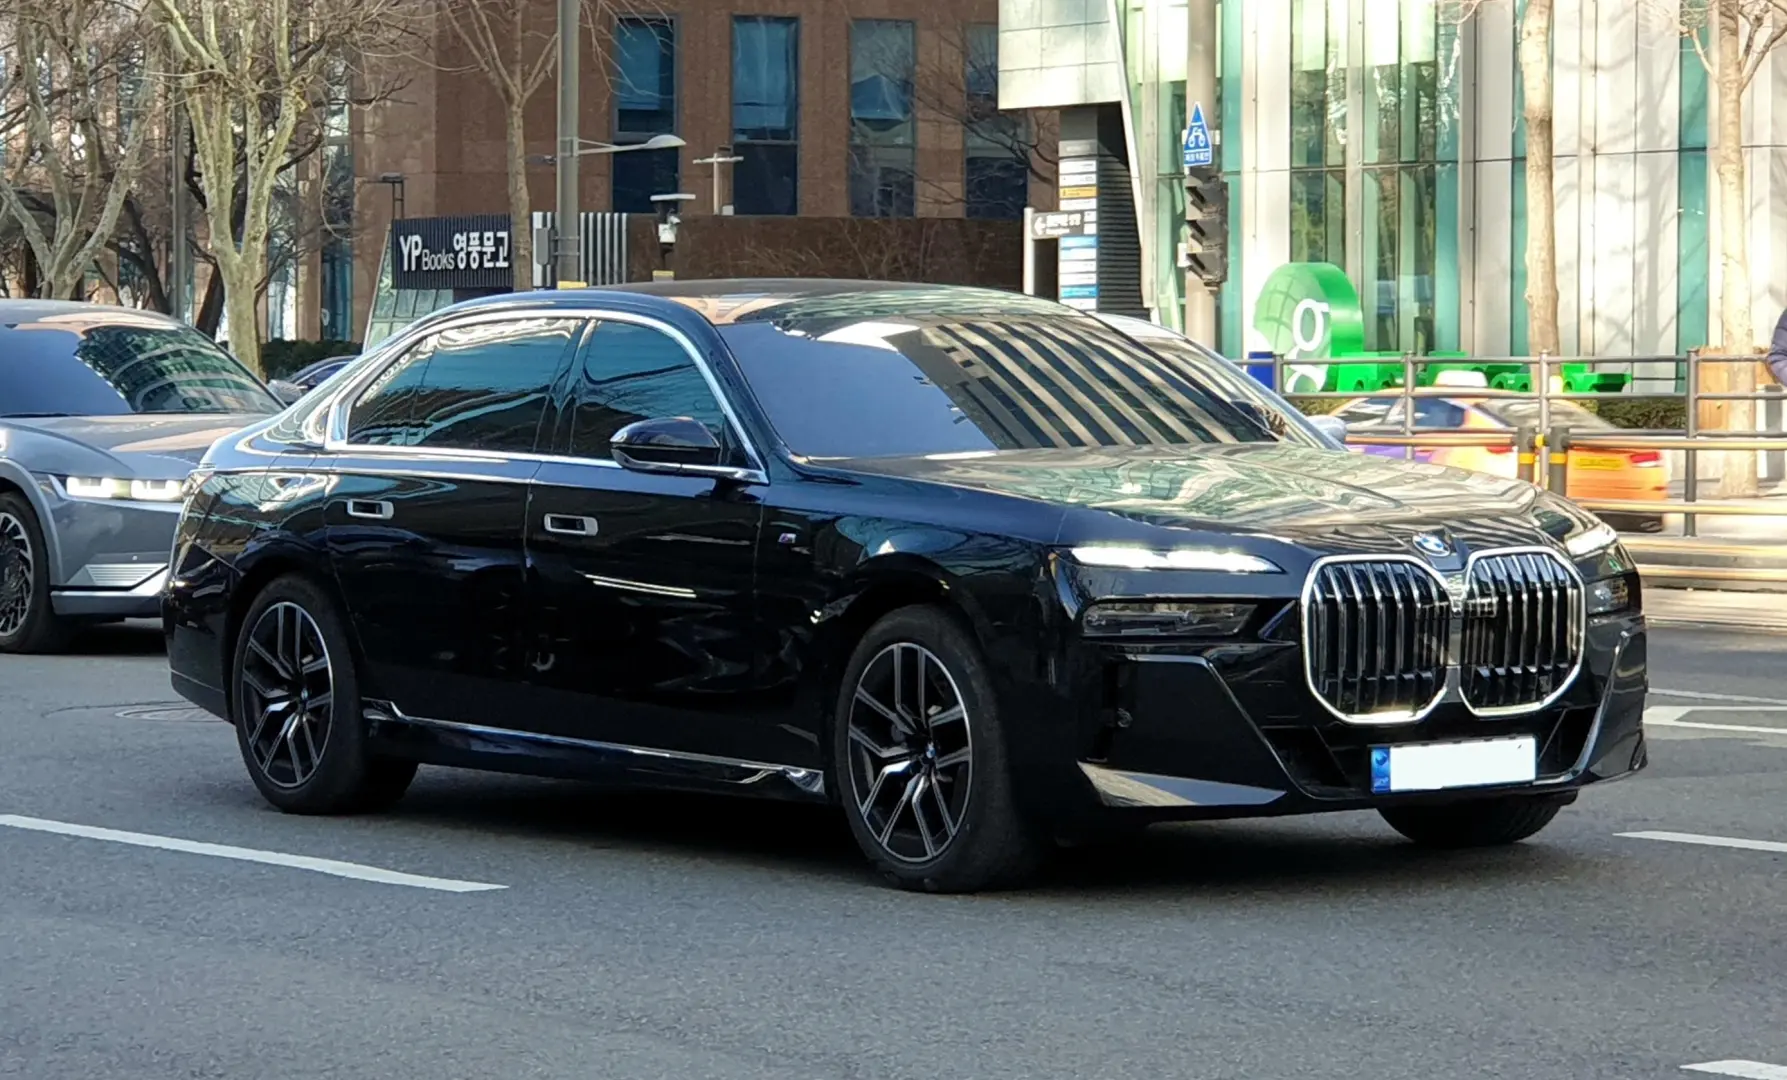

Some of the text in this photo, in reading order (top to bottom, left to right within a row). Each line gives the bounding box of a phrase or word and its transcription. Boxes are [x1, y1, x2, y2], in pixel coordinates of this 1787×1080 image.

[399, 231, 509, 271] YP Books 영풍문고
